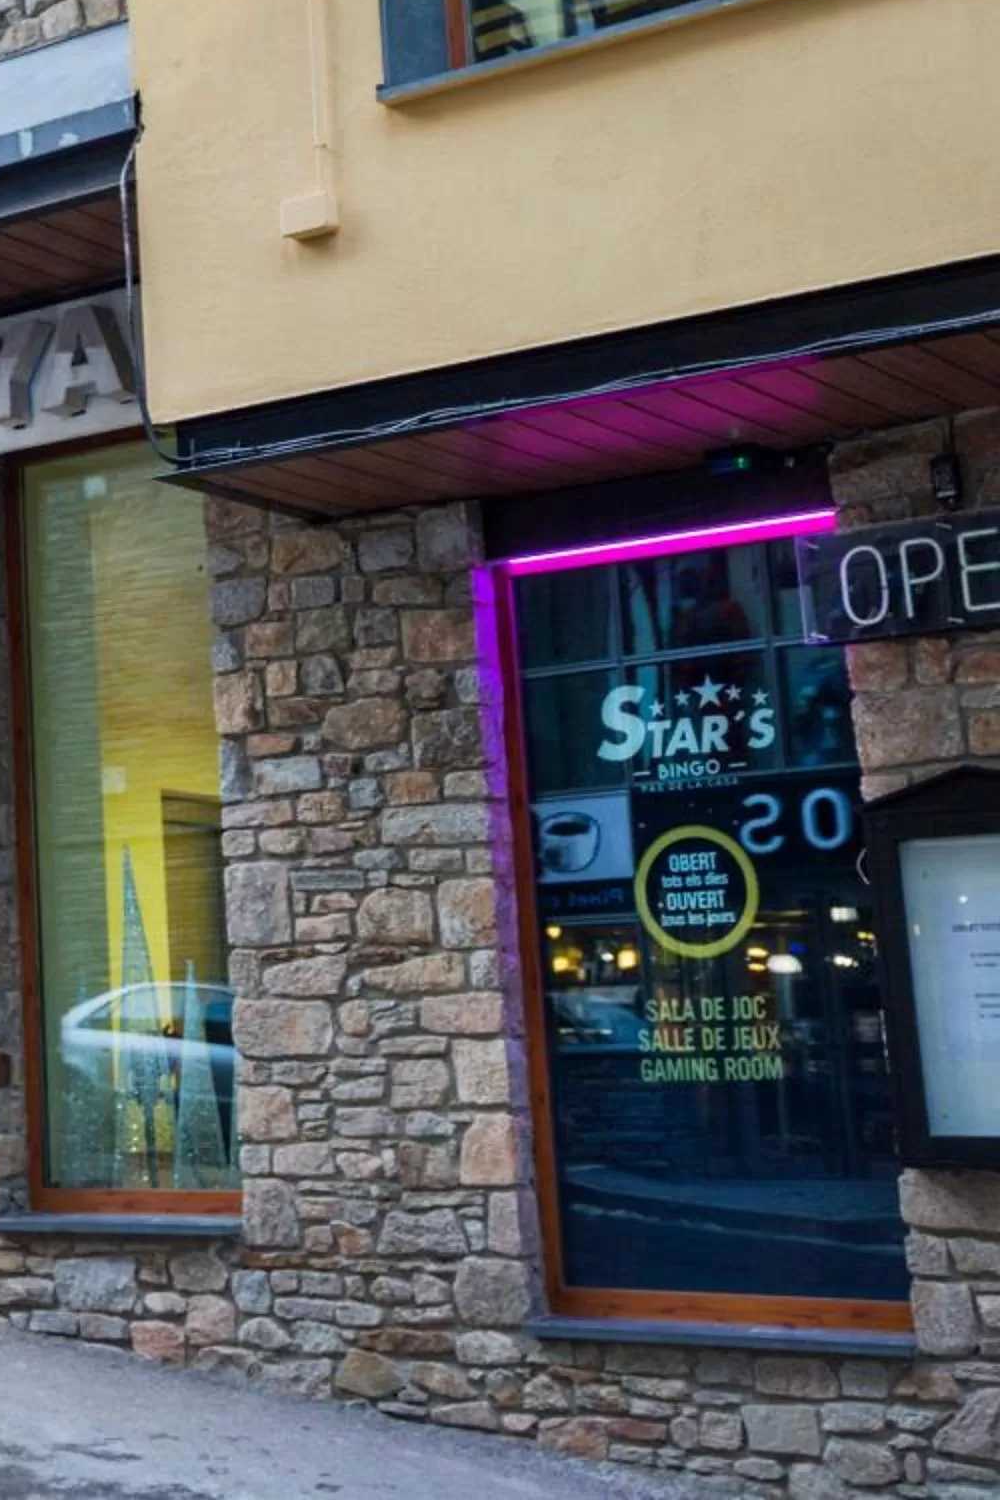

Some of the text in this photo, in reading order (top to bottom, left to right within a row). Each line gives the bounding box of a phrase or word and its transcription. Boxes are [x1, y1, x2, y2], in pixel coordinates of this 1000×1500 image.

[658, 759, 721, 780] BINGO
[668, 851, 717, 872] OBERT
[666, 889, 725, 911] OUVERT
[645, 995, 767, 1022] SALA DE JOC
[637, 1023, 781, 1052] SALLE DE JEUX
[640, 1055, 785, 1082] GAMING ROOM
